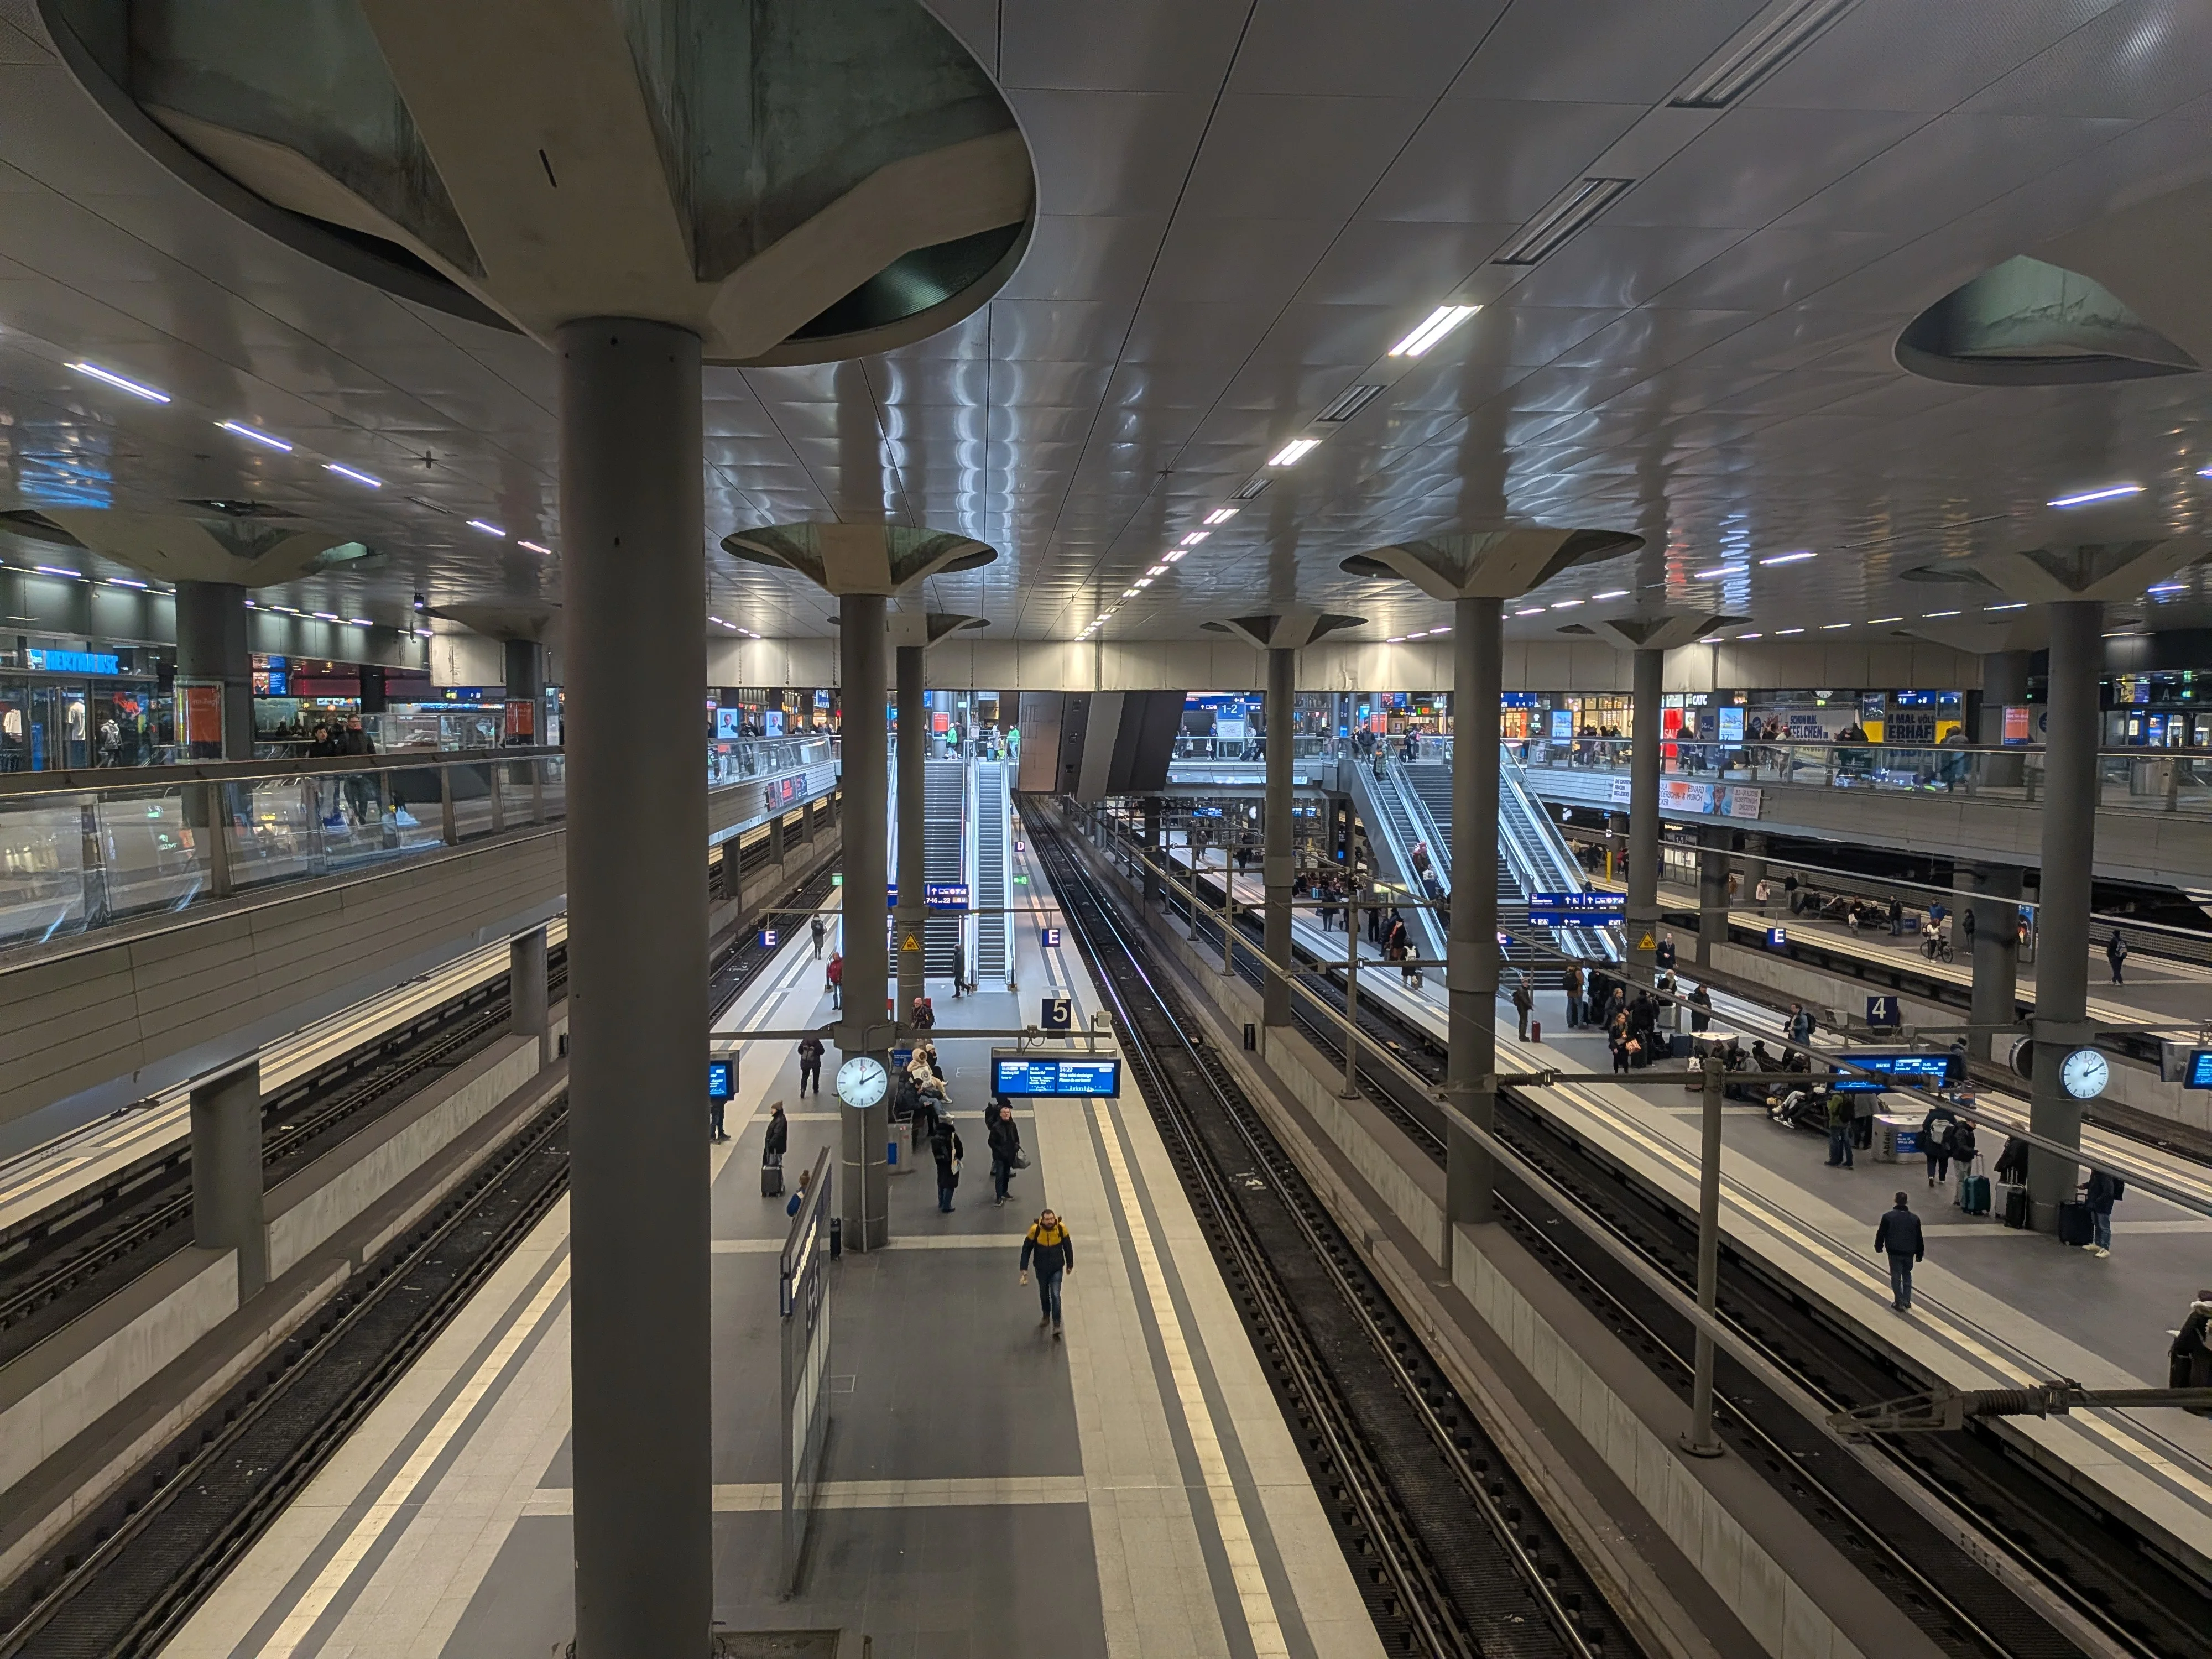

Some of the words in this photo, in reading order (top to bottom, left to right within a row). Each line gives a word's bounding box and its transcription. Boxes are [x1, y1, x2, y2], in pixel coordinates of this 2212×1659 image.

[1222, 704, 1238, 713] 1-2
[1896, 714, 1916, 724] MAL
[1888, 724, 1934, 739] ERHAF
[1017, 842, 1025, 851] D
[765, 930, 775, 946] E
[1048, 929, 1059, 944] E
[1775, 928, 1785, 943] E
[1053, 1000, 1068, 1022] 5
[1872, 997, 1886, 1019] 4
